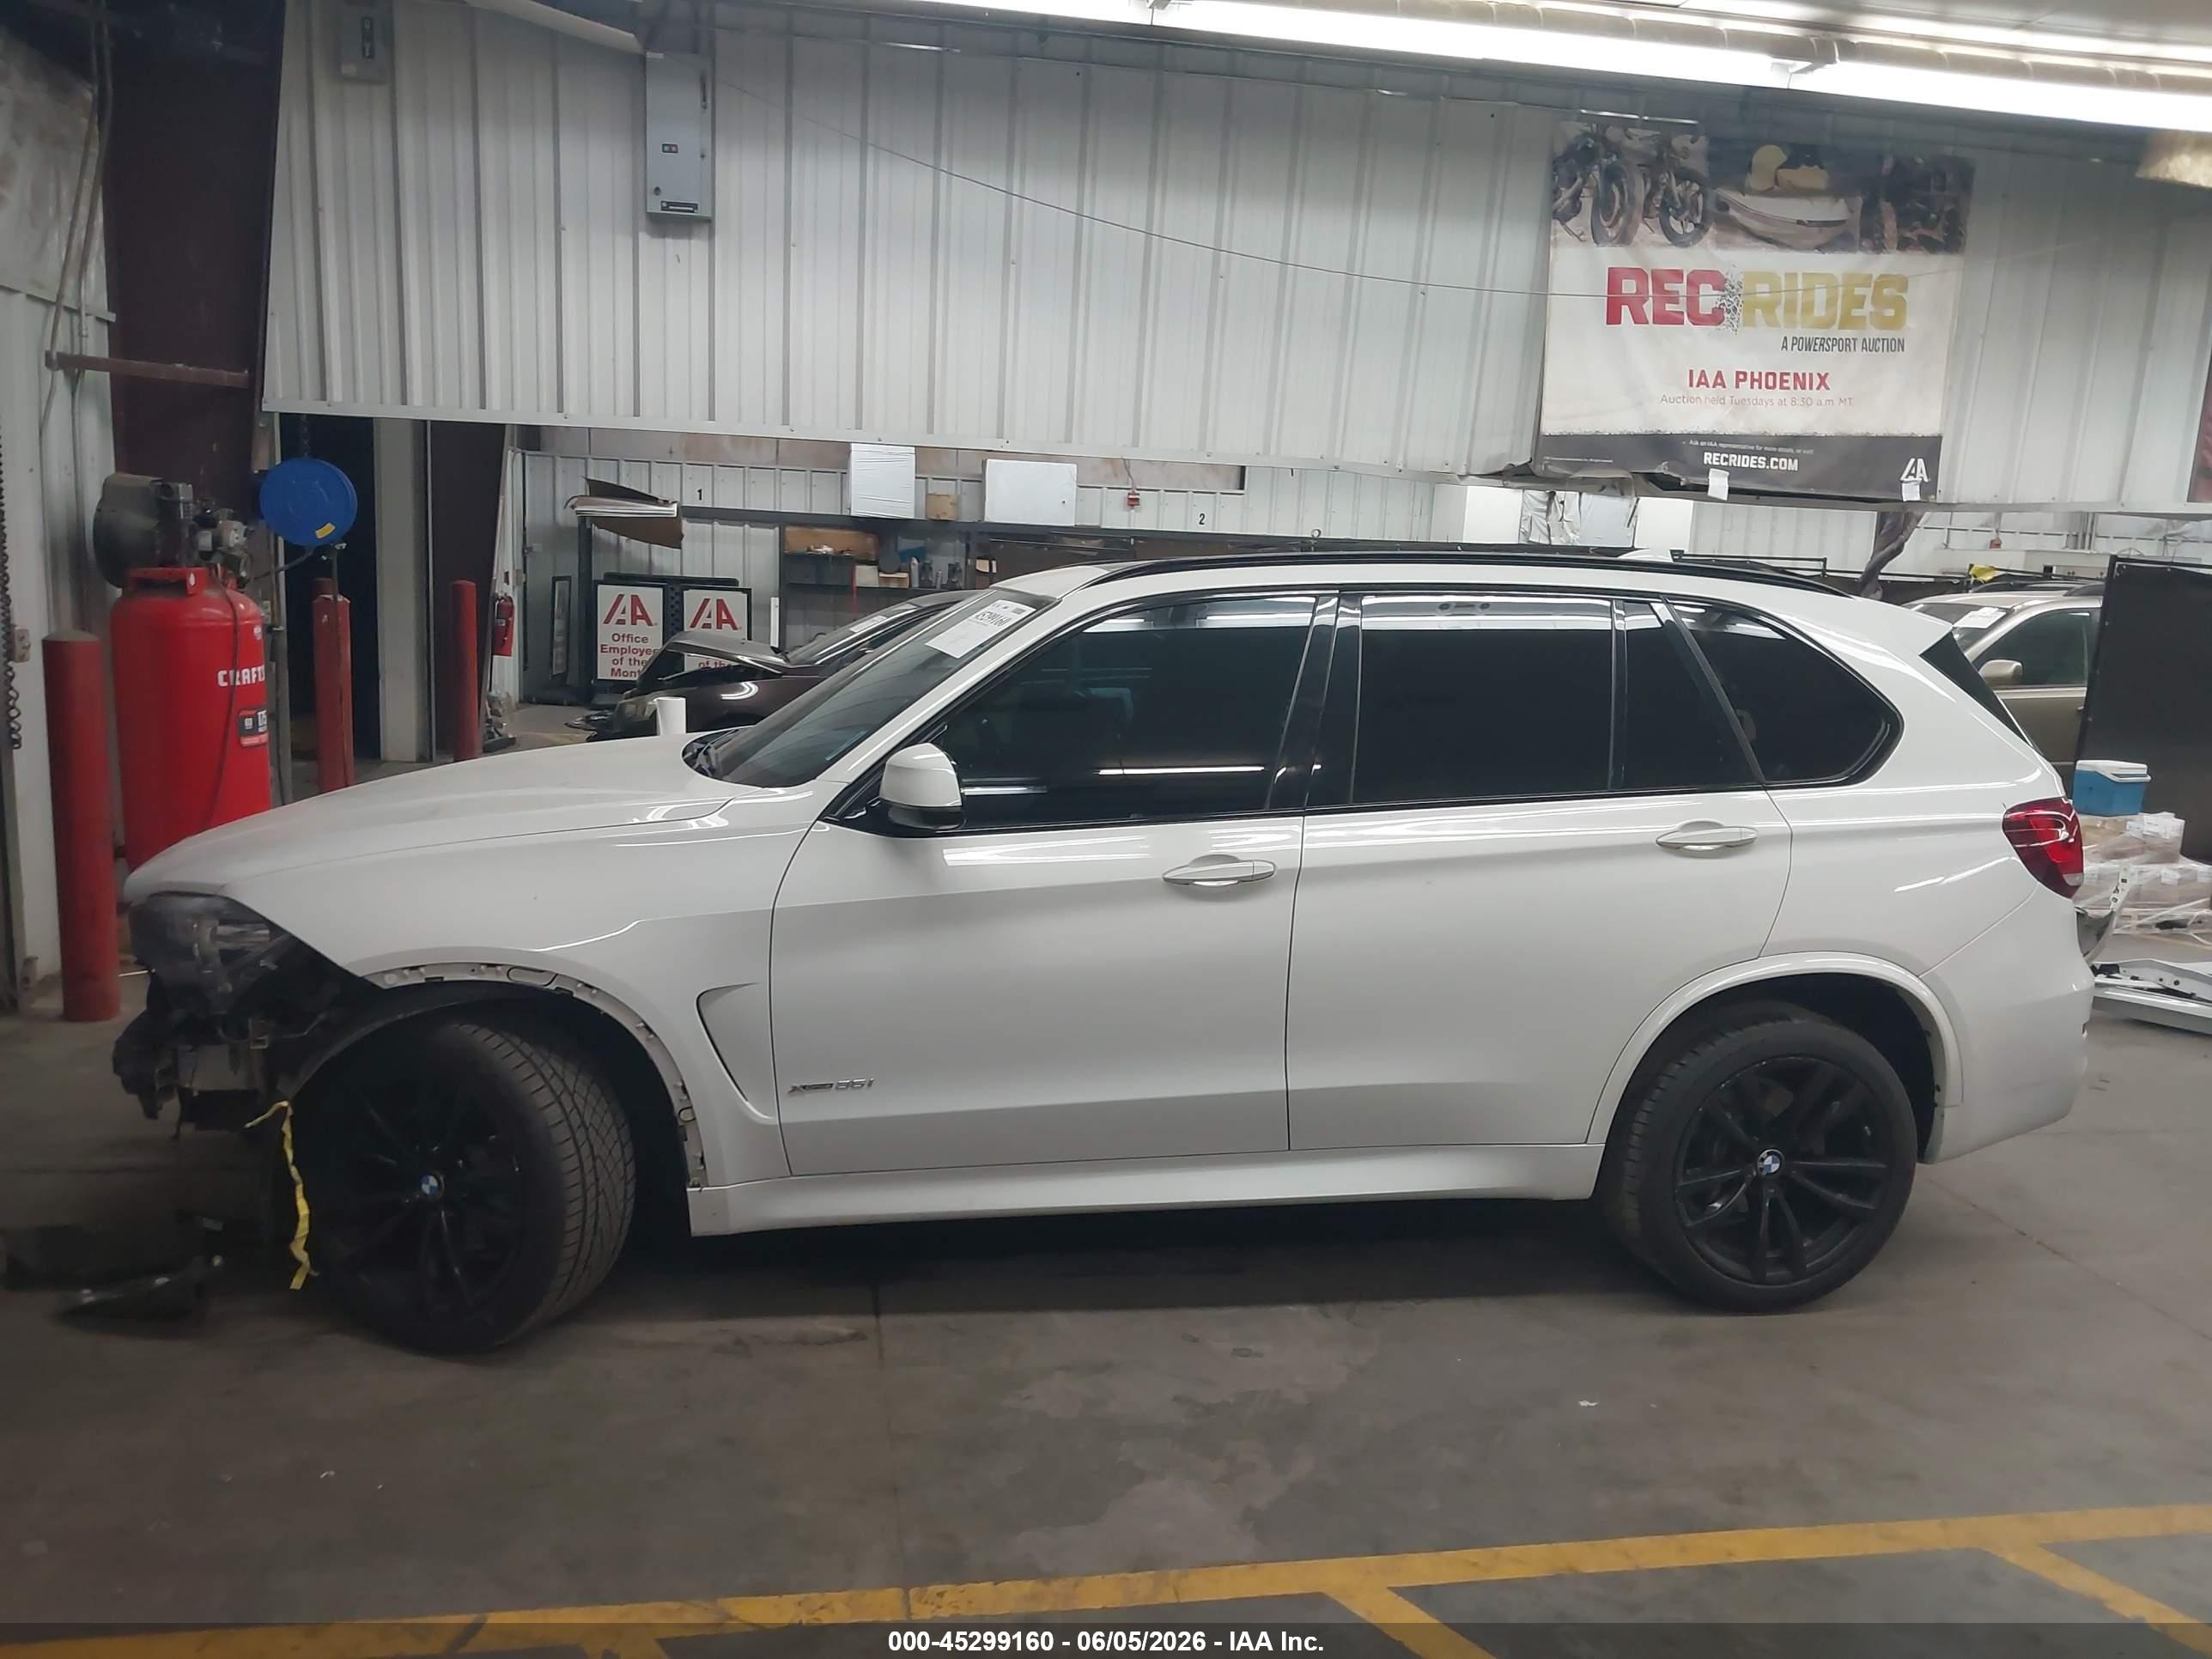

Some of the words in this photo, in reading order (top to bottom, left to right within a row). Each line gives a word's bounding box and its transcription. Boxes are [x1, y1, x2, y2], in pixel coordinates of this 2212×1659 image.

[1607, 267, 1725, 326] REC
[1742, 270, 1909, 331] RIDES
[1781, 336, 1788, 351] A
[1791, 336, 1858, 352] POWERSPORT
[1862, 337, 1905, 352] AUCTION
[1688, 369, 1727, 388] IAA
[1735, 370, 1831, 391] PHOENIX
[1661, 393, 1701, 404] Auction
[1729, 395, 1774, 408] Tuesdays
[1778, 397, 1787, 406] at
[1704, 452, 1799, 471] RECRIDES.COM
[697, 488, 702, 501] 1
[1199, 513, 1206, 525] 2
[611, 632, 649, 644] Office
[612, 656, 624, 666] of
